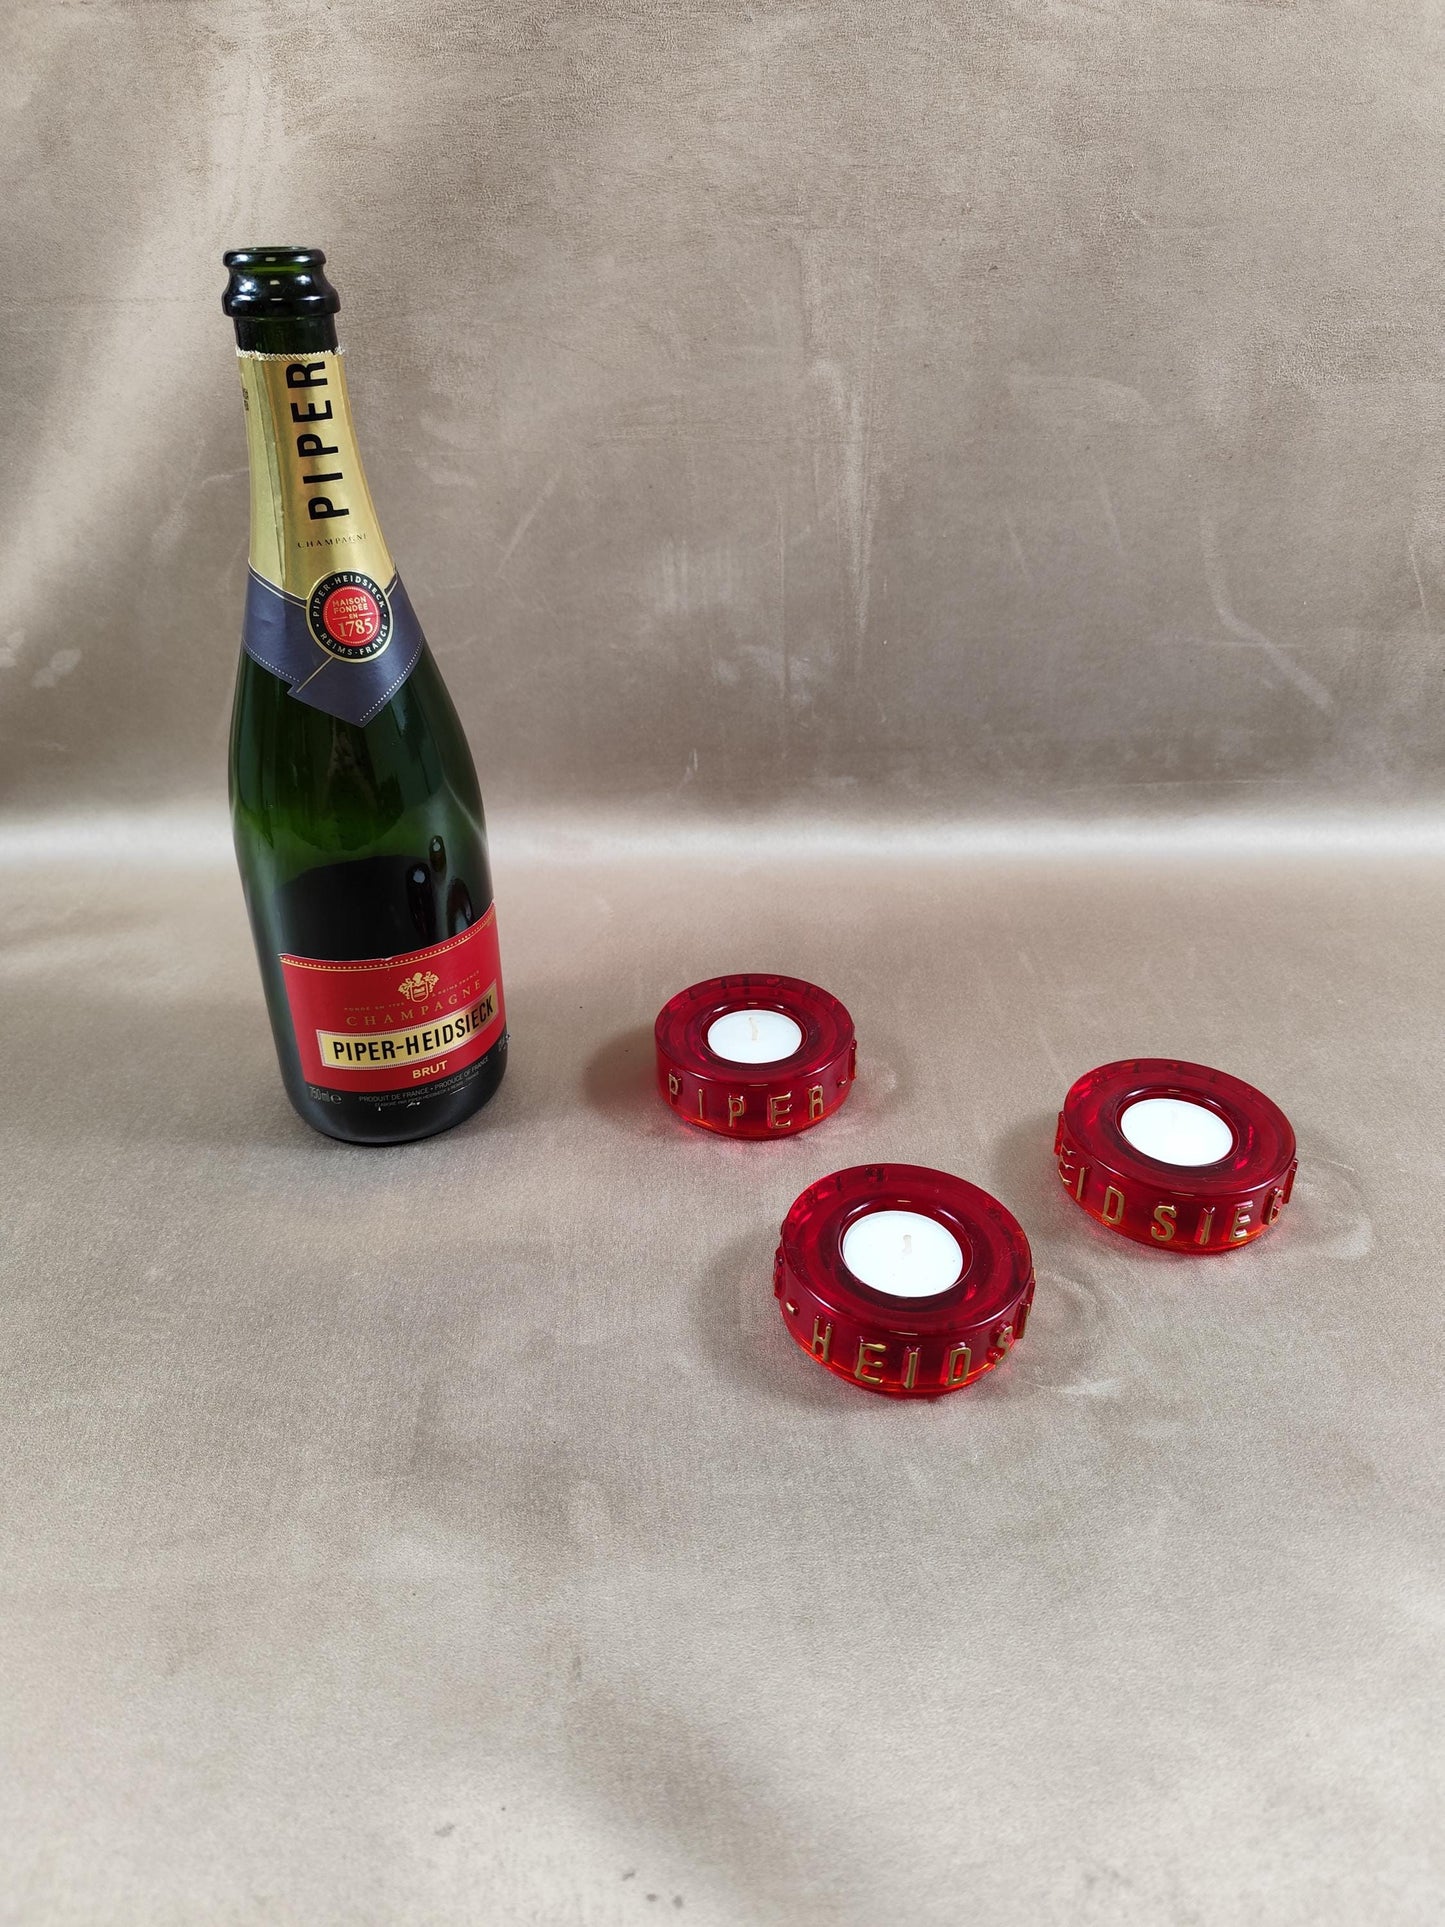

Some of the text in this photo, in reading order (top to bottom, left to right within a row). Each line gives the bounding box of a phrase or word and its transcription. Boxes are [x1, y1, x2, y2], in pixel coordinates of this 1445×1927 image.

[286, 361, 350, 520] PIPER
[332, 596, 367, 607] MAISON
[338, 618, 374, 637] 1785
[346, 979, 481, 1026] CHAMPAGNE
[333, 995, 494, 1062] PIPER-HEIDSIECK
[412, 1060, 448, 1079] BRUT
